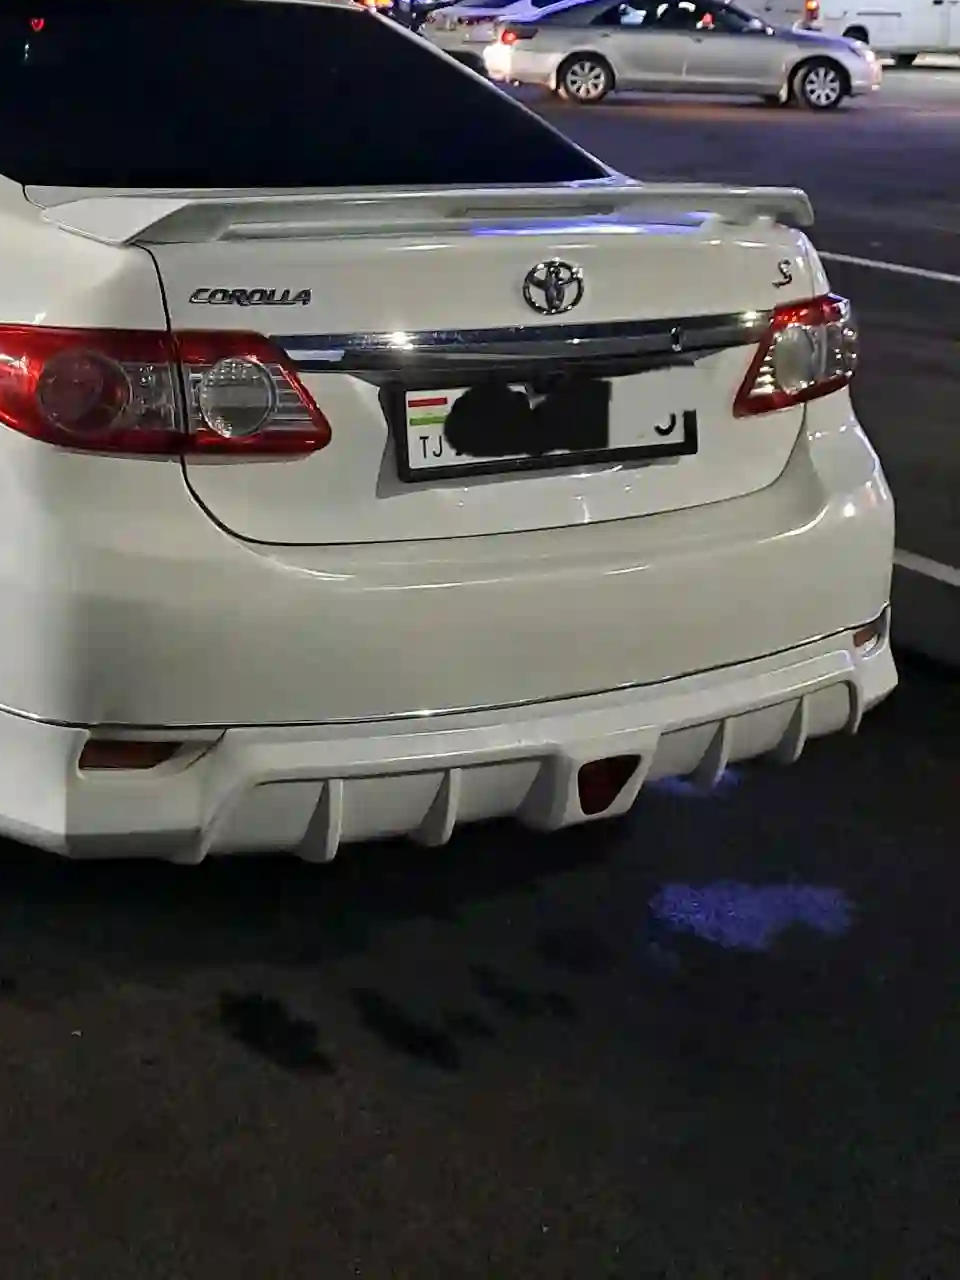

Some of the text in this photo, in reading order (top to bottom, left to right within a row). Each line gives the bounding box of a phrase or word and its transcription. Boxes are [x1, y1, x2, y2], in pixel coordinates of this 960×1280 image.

[771, 259, 793, 289] S
[188, 287, 312, 307] COROLLA
[419, 435, 444, 459] TJ
